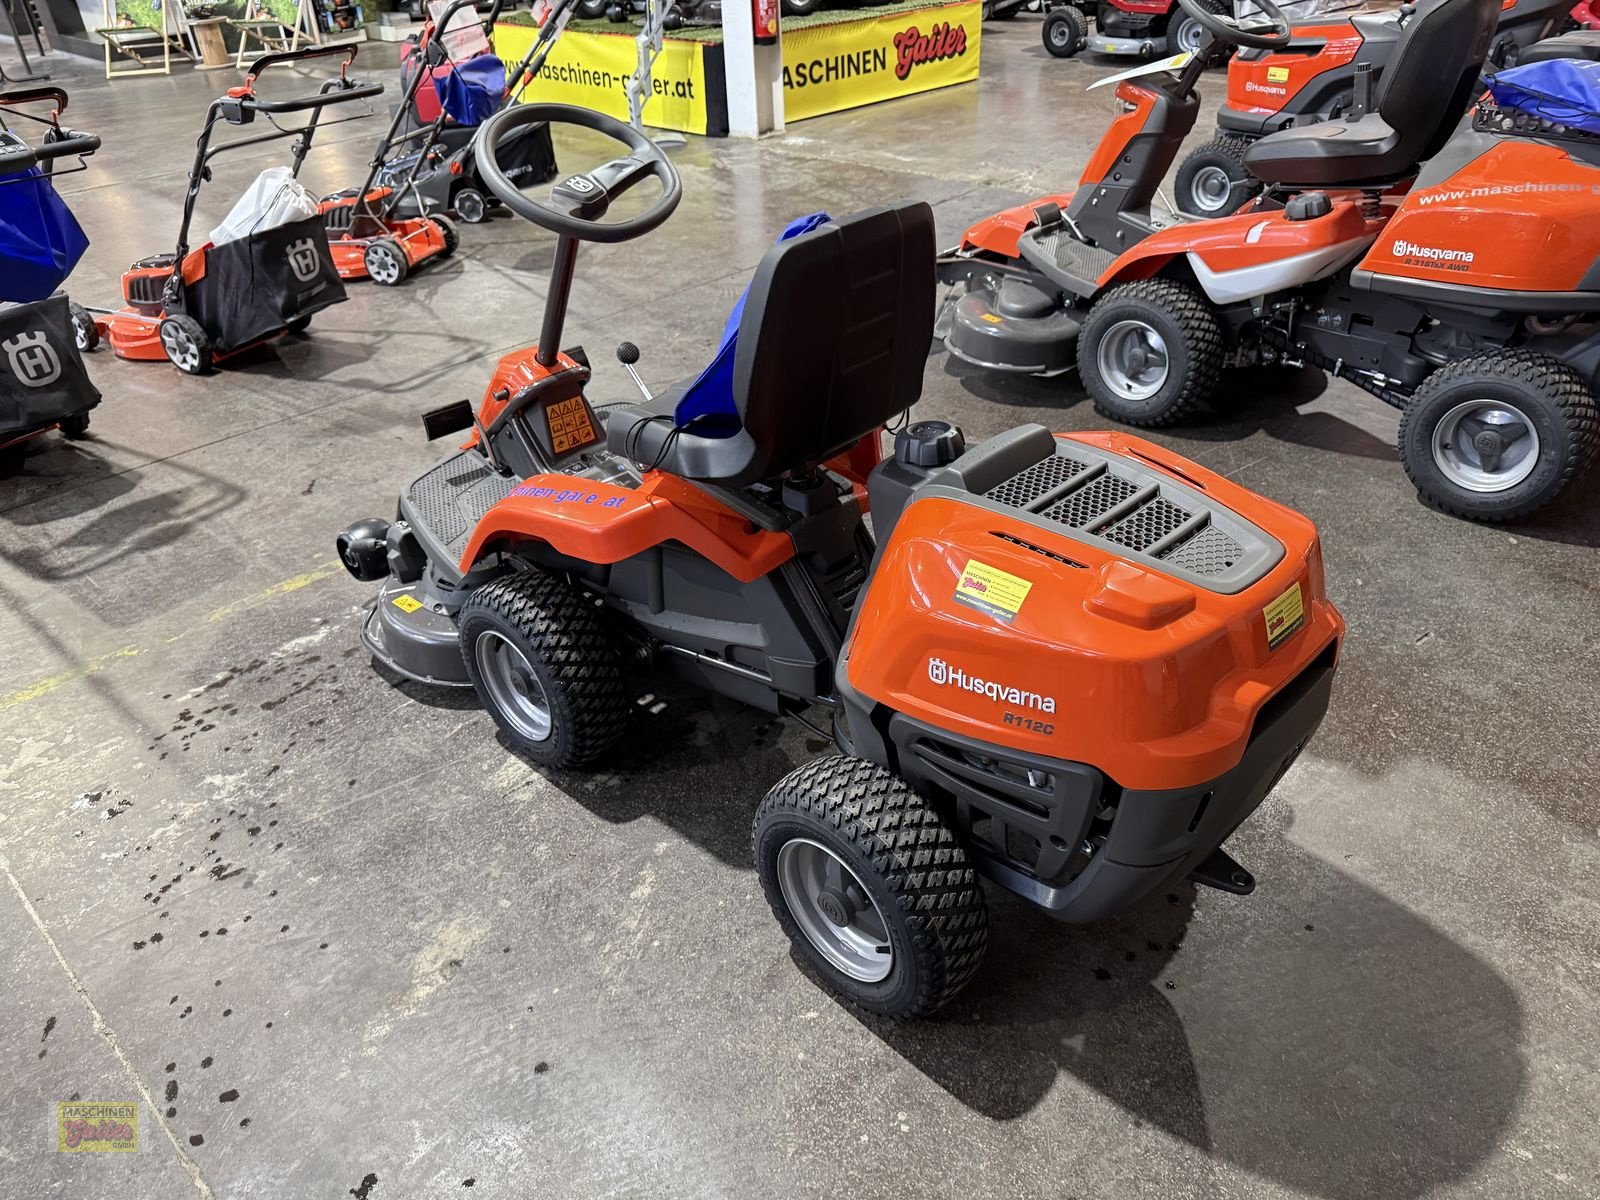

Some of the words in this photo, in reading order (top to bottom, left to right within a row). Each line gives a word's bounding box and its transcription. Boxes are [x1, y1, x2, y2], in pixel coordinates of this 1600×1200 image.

[783, 47, 887, 89] ASCHINEN
[893, 21, 967, 81] Gailer
[1252, 83, 1287, 95] Husqvarna
[1406, 243, 1474, 262] Husqvarna
[1447, 262, 1470, 272] AWD
[948, 665, 1056, 713] Husqvarna
[1003, 712, 1055, 735] R112C
